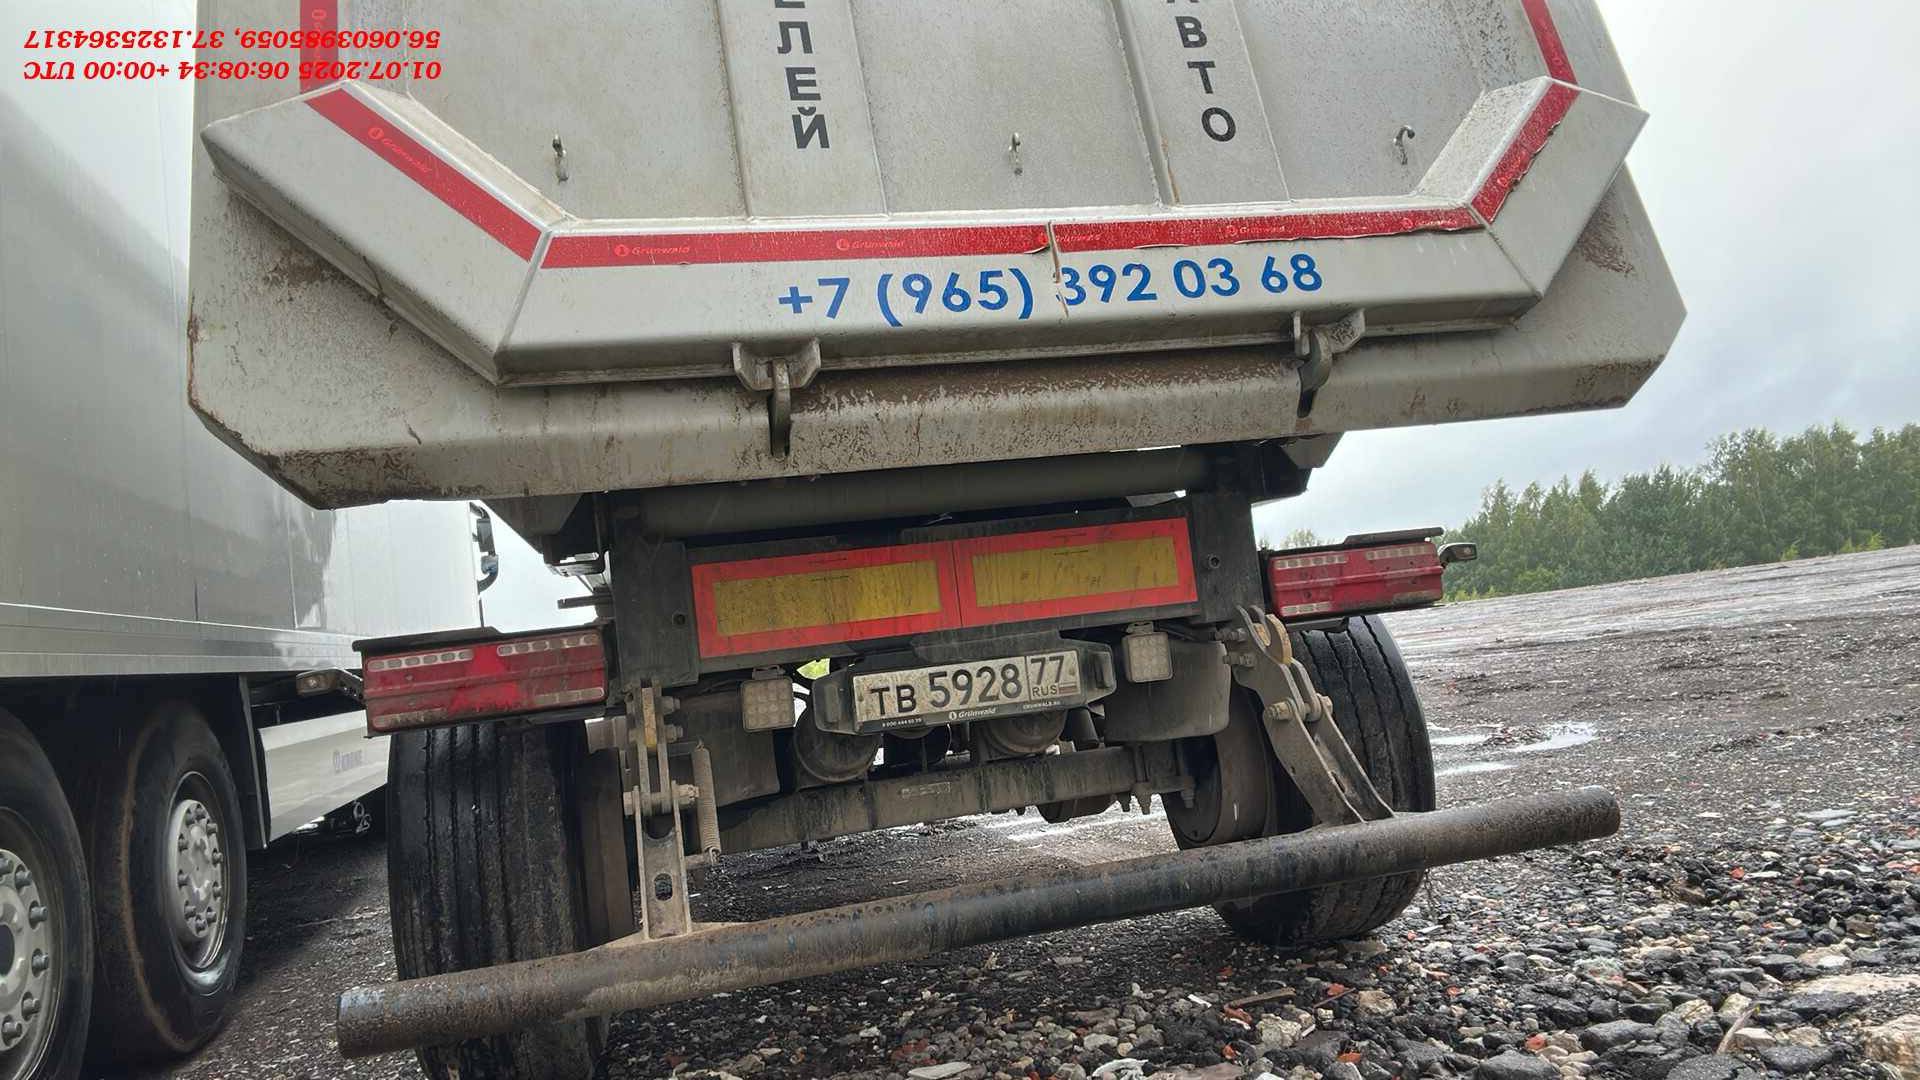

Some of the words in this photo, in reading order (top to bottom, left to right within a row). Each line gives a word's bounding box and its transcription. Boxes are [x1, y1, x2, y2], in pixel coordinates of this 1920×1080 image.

[775, 0, 830, 149] ЛЕЙ
[1167, 0, 1237, 143] ВТО
[780, 277, 849, 319] +7
[877, 267, 1034, 327] (965)
[1056, 263, 1157, 306] 392
[1173, 257, 1240, 298] 03
[1260, 252, 1322, 294] 68
[928, 663, 1023, 708] 5928
[1030, 656, 1065, 686] 77
[1032, 684, 1058, 698] RUS
